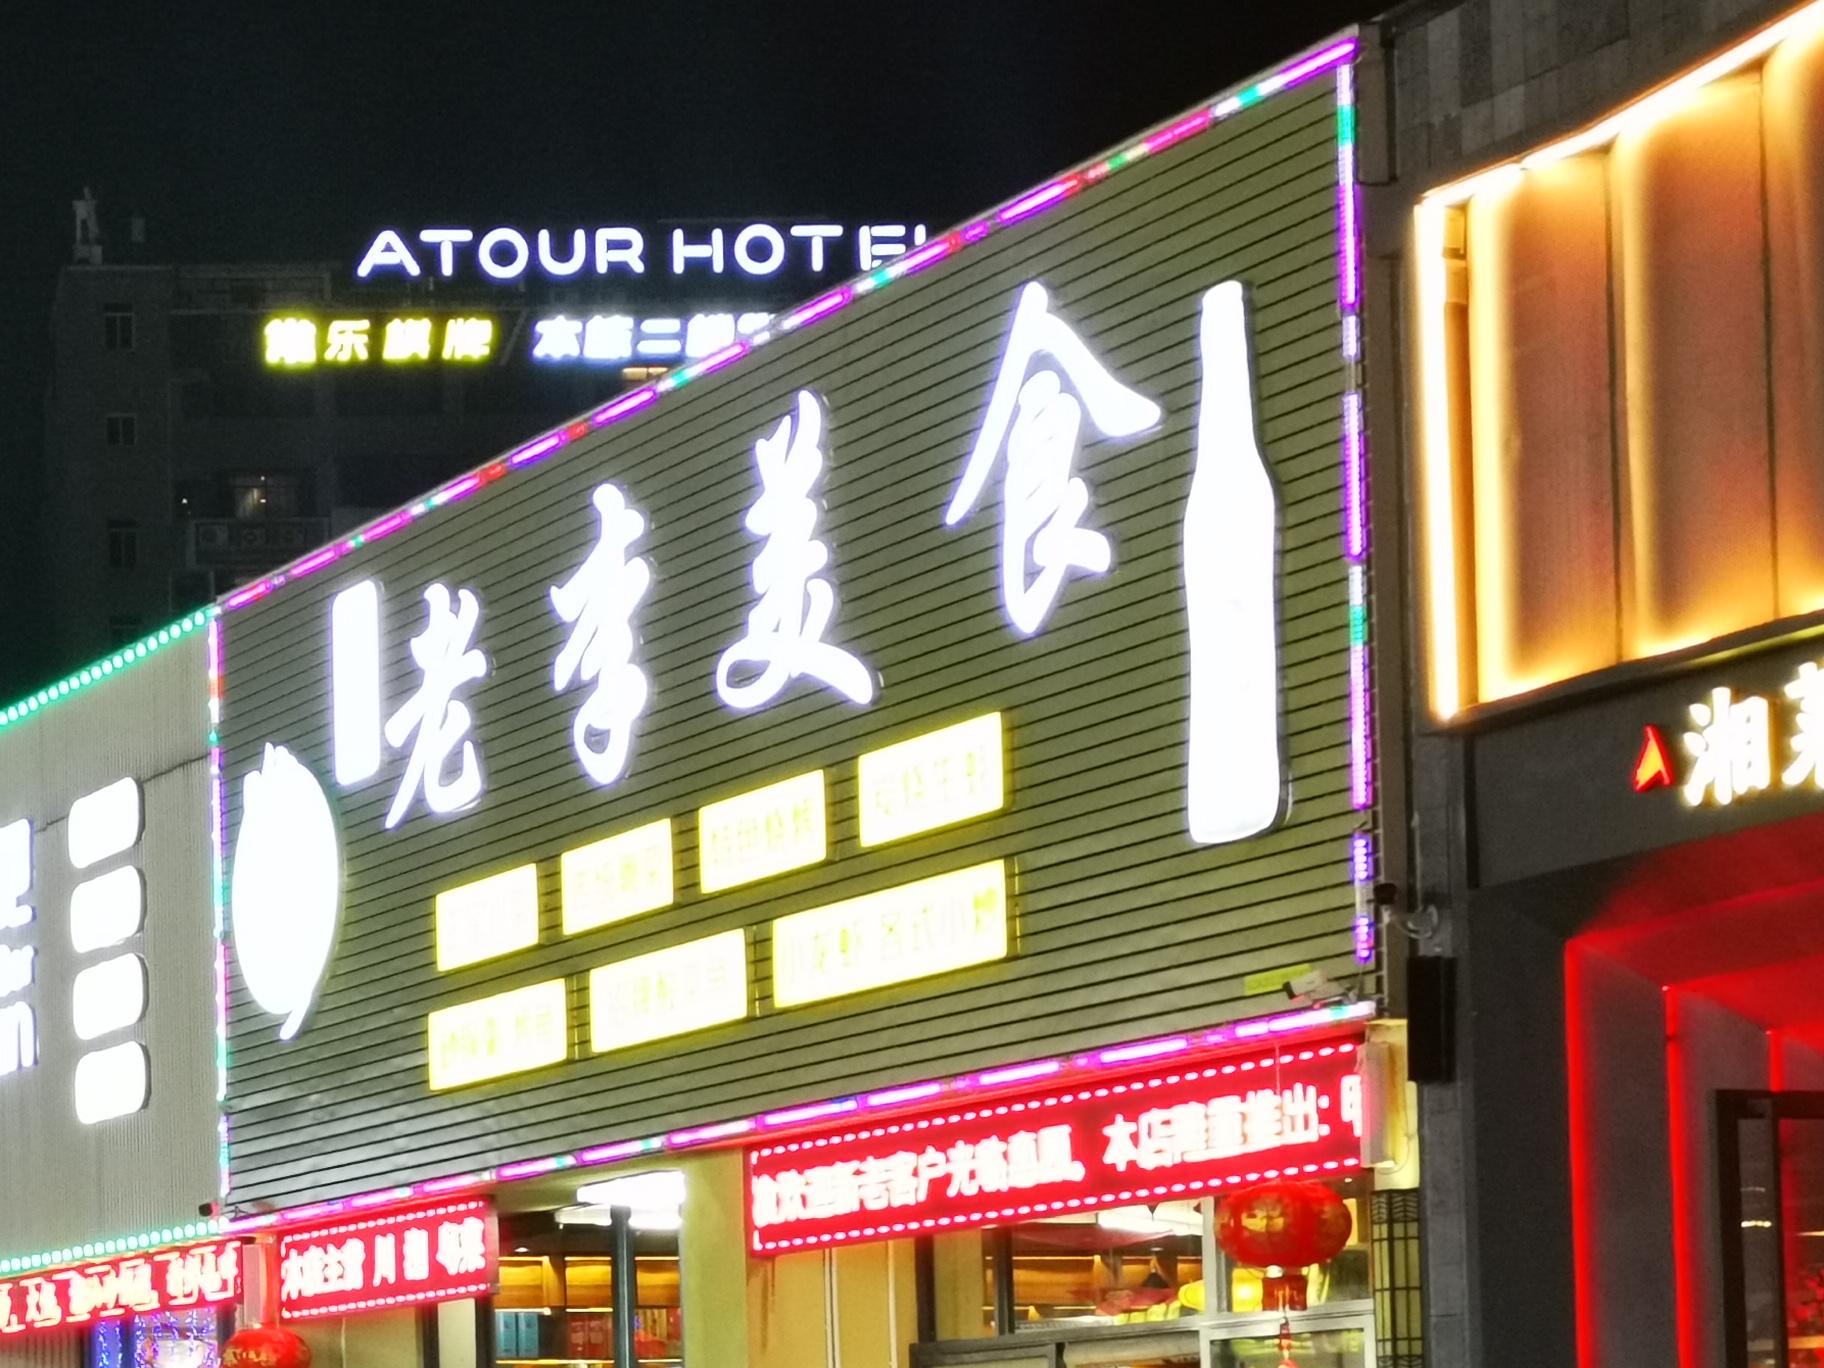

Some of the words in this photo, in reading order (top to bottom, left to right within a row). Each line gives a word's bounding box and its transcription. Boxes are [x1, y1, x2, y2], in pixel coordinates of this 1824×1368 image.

[356, 227, 644, 279] ATOUR
[673, 224, 926, 275] HOTE
[384, 281, 1161, 828] 老李美食
